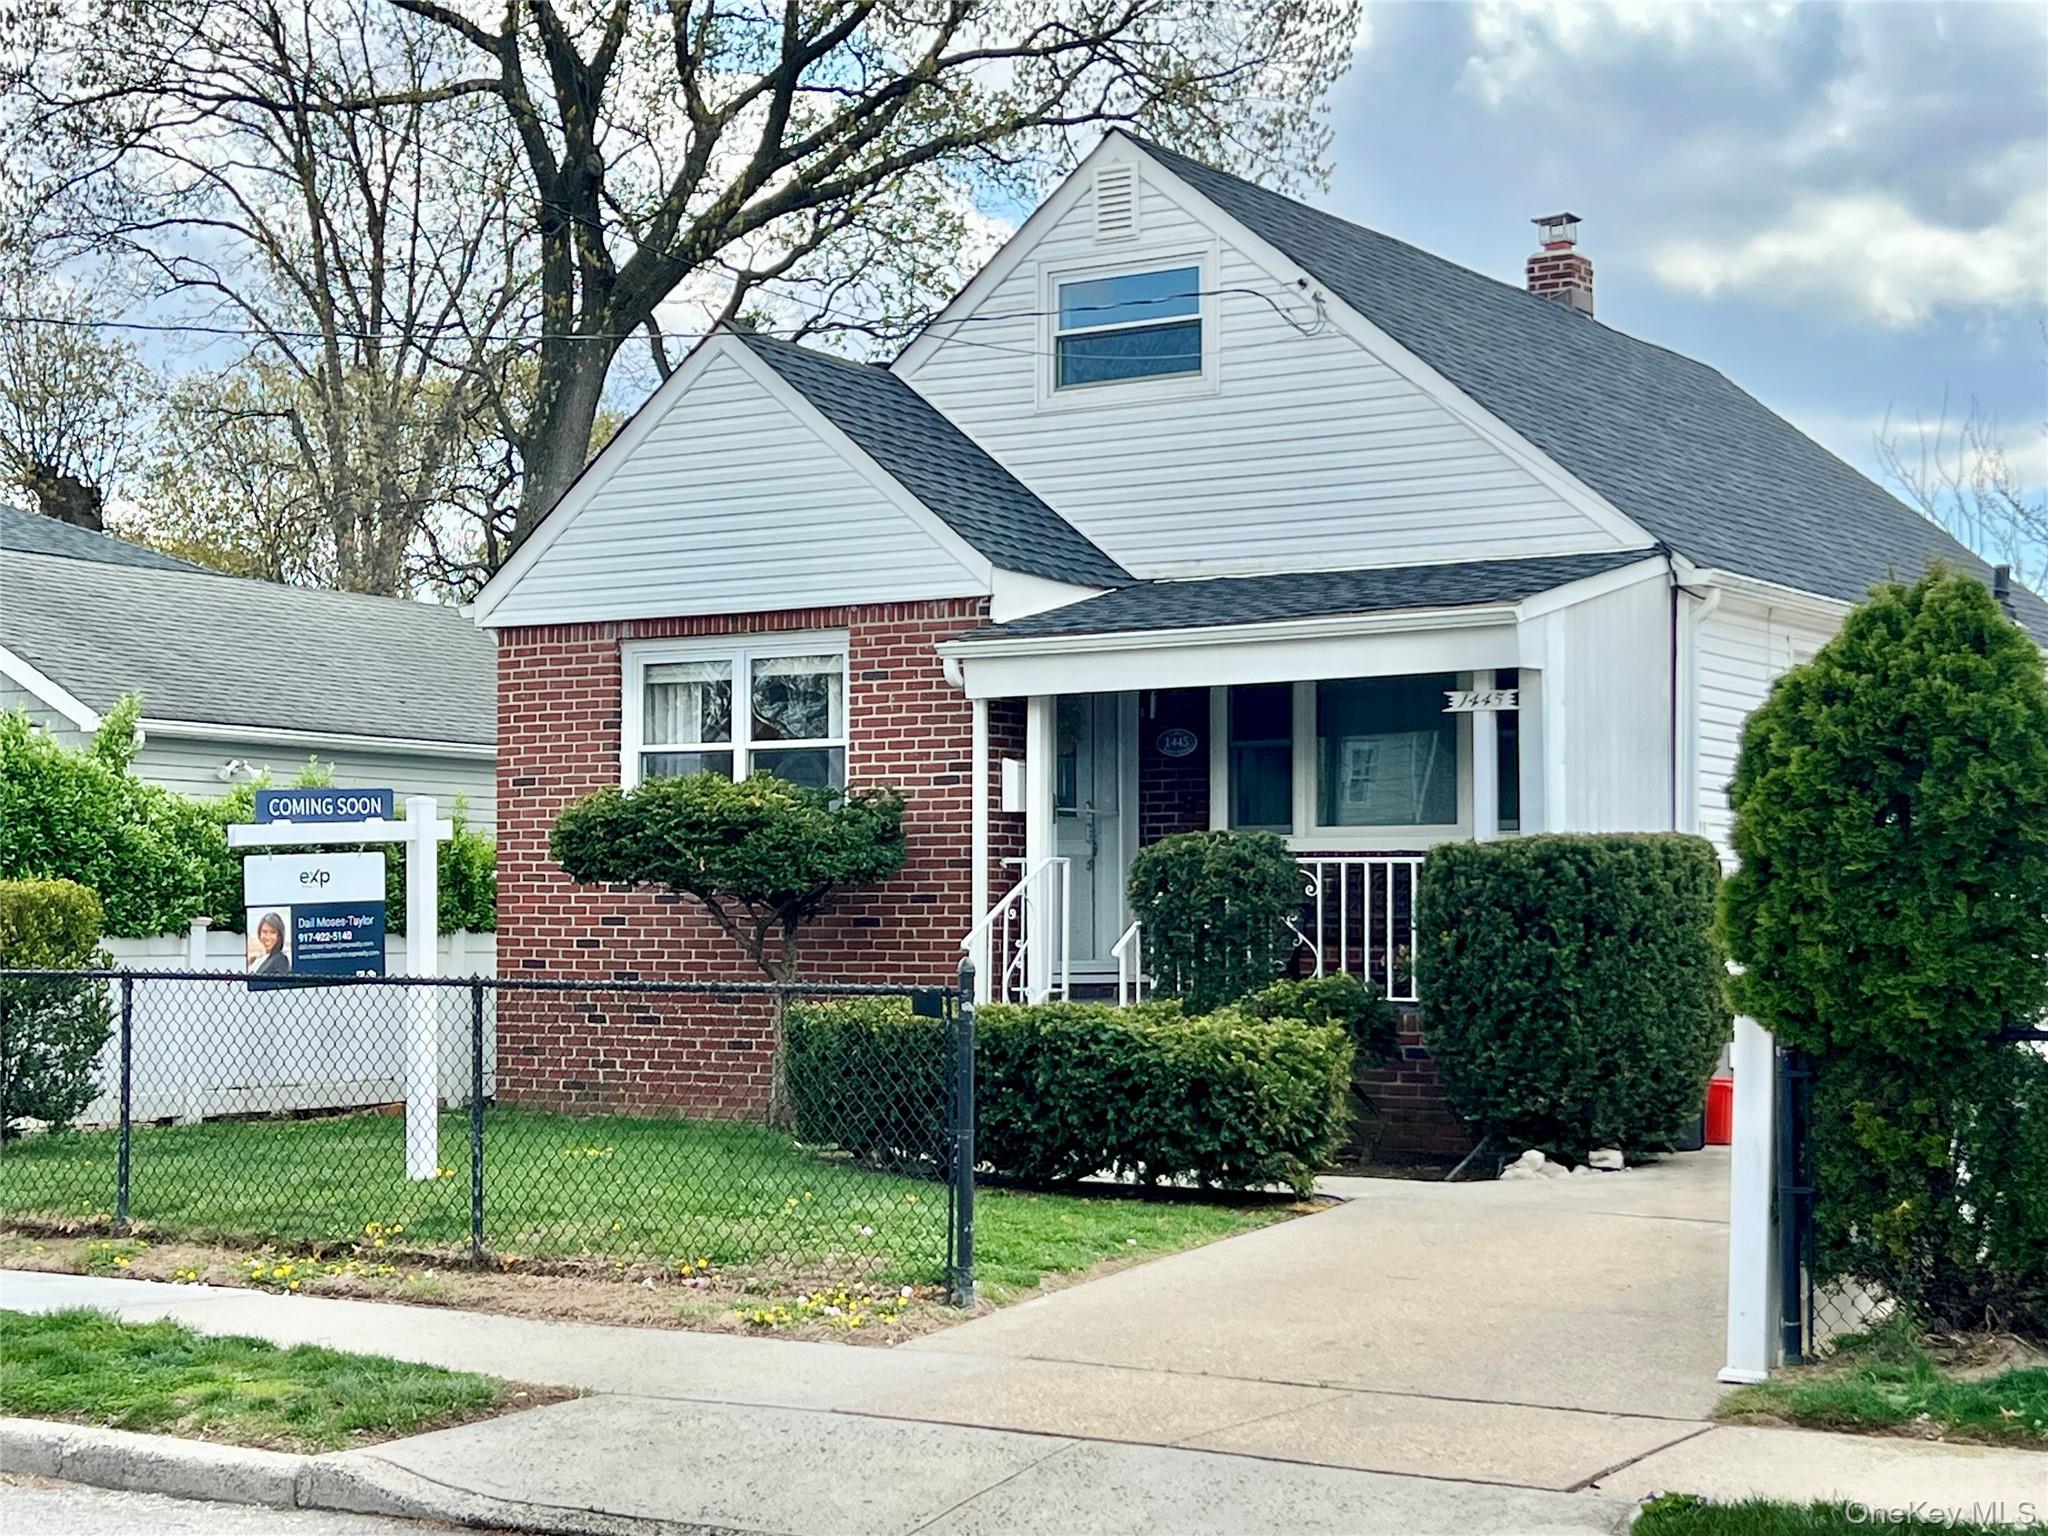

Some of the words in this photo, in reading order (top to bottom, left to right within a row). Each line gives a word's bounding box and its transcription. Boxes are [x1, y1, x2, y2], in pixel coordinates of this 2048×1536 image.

[1458, 692, 1505, 708] 1445
[1164, 736, 1190, 748] 1445
[268, 797, 334, 816] COMING
[336, 797, 382, 815] SOON
